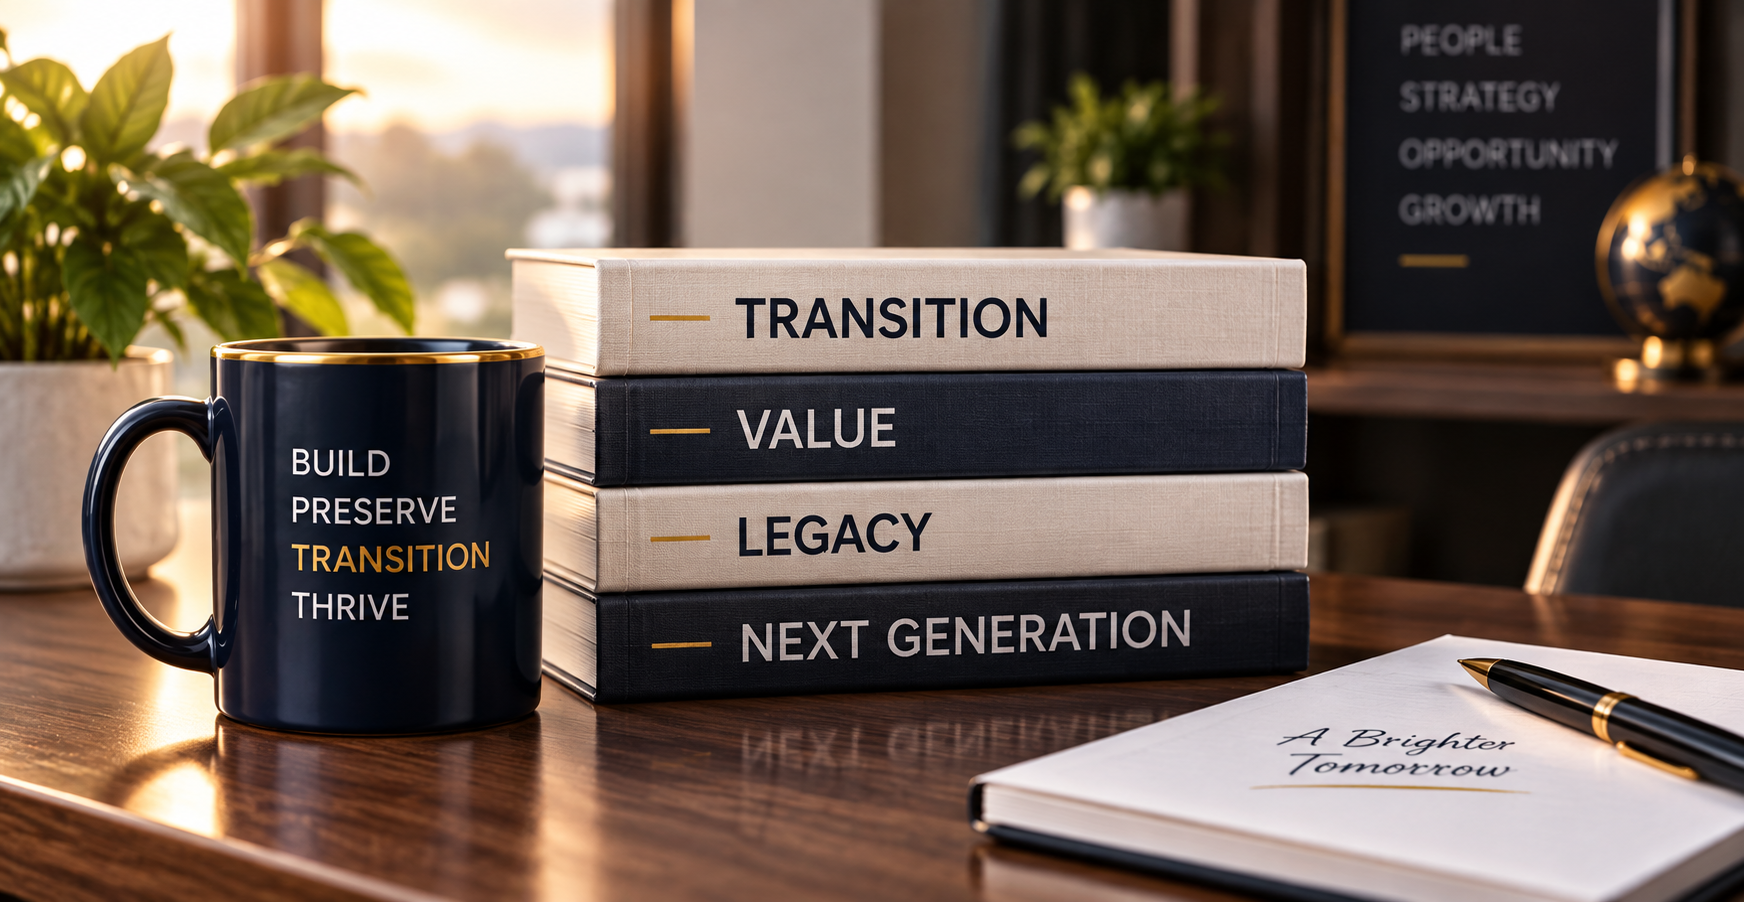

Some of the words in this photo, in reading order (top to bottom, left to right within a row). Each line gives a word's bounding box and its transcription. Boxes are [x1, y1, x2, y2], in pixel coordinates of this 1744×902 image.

[1401, 24, 1521, 55] PEOPLE
[1400, 81, 1560, 112] STRATEGY
[1399, 138, 1618, 169] OPPORTUNITY
[1399, 194, 1540, 224] GROWTH
[735, 298, 1048, 339] TRANSITION
[737, 407, 896, 450] VALUE
[292, 449, 390, 477] BUILD
[292, 496, 457, 525] PRESERVE
[738, 512, 932, 557] LEGACY
[292, 541, 490, 573] TRANSITION
[292, 592, 409, 621] THRIVE
[742, 619, 870, 663] NEXT
[887, 609, 1191, 658] GENERATION
[1276, 727, 1330, 746] A
[1343, 729, 1515, 756] Brighter
[1289, 753, 1516, 777] Tomorrow
